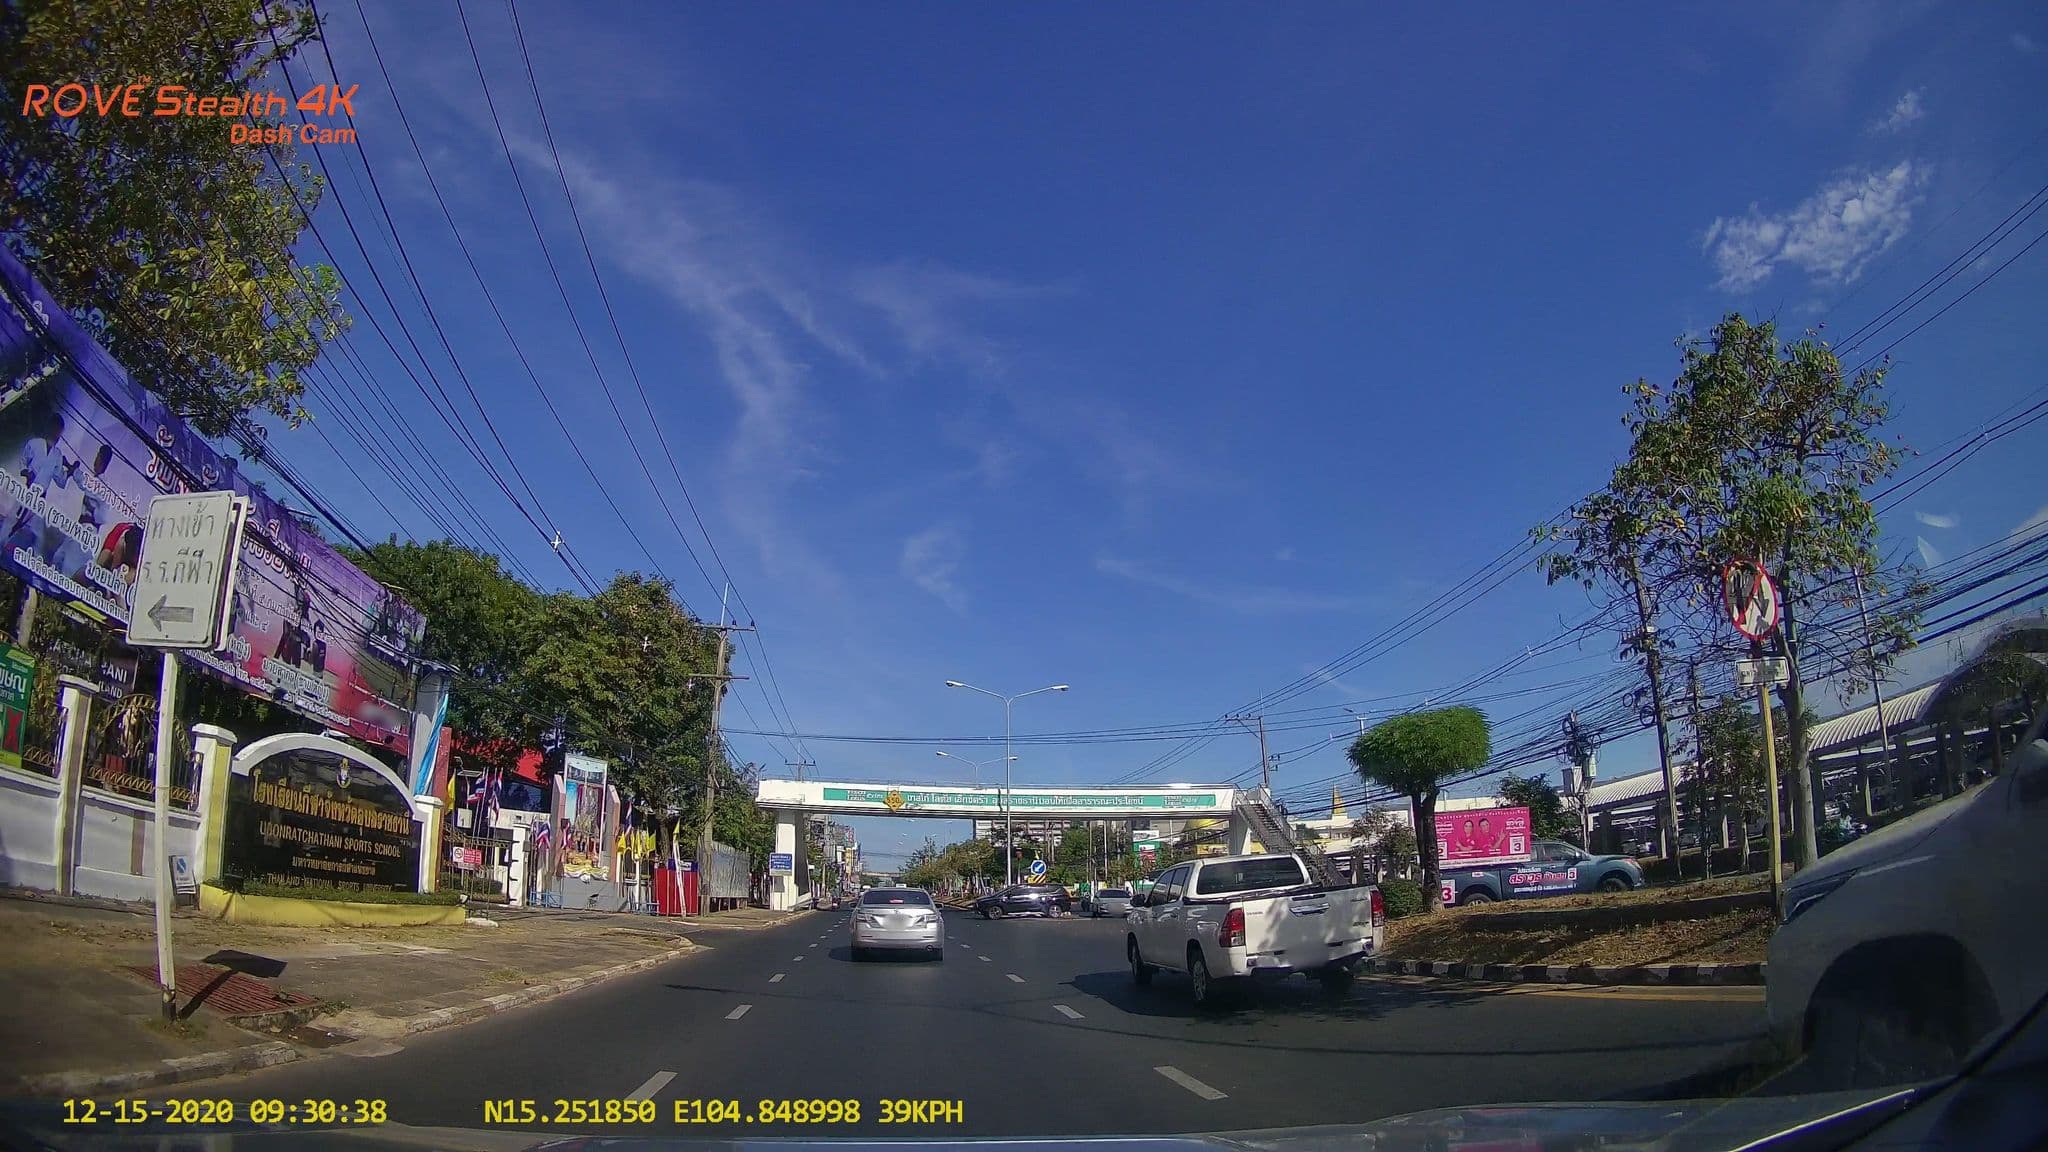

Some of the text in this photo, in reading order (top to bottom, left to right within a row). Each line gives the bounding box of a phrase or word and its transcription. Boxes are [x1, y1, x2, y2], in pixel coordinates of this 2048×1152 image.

[152, 502, 215, 540] ทางเข้า
[343, 837, 372, 854] SPORTS
[373, 842, 401, 858] SCHOOL
[1513, 842, 1522, 852] 3
[1441, 887, 1453, 902] 3
